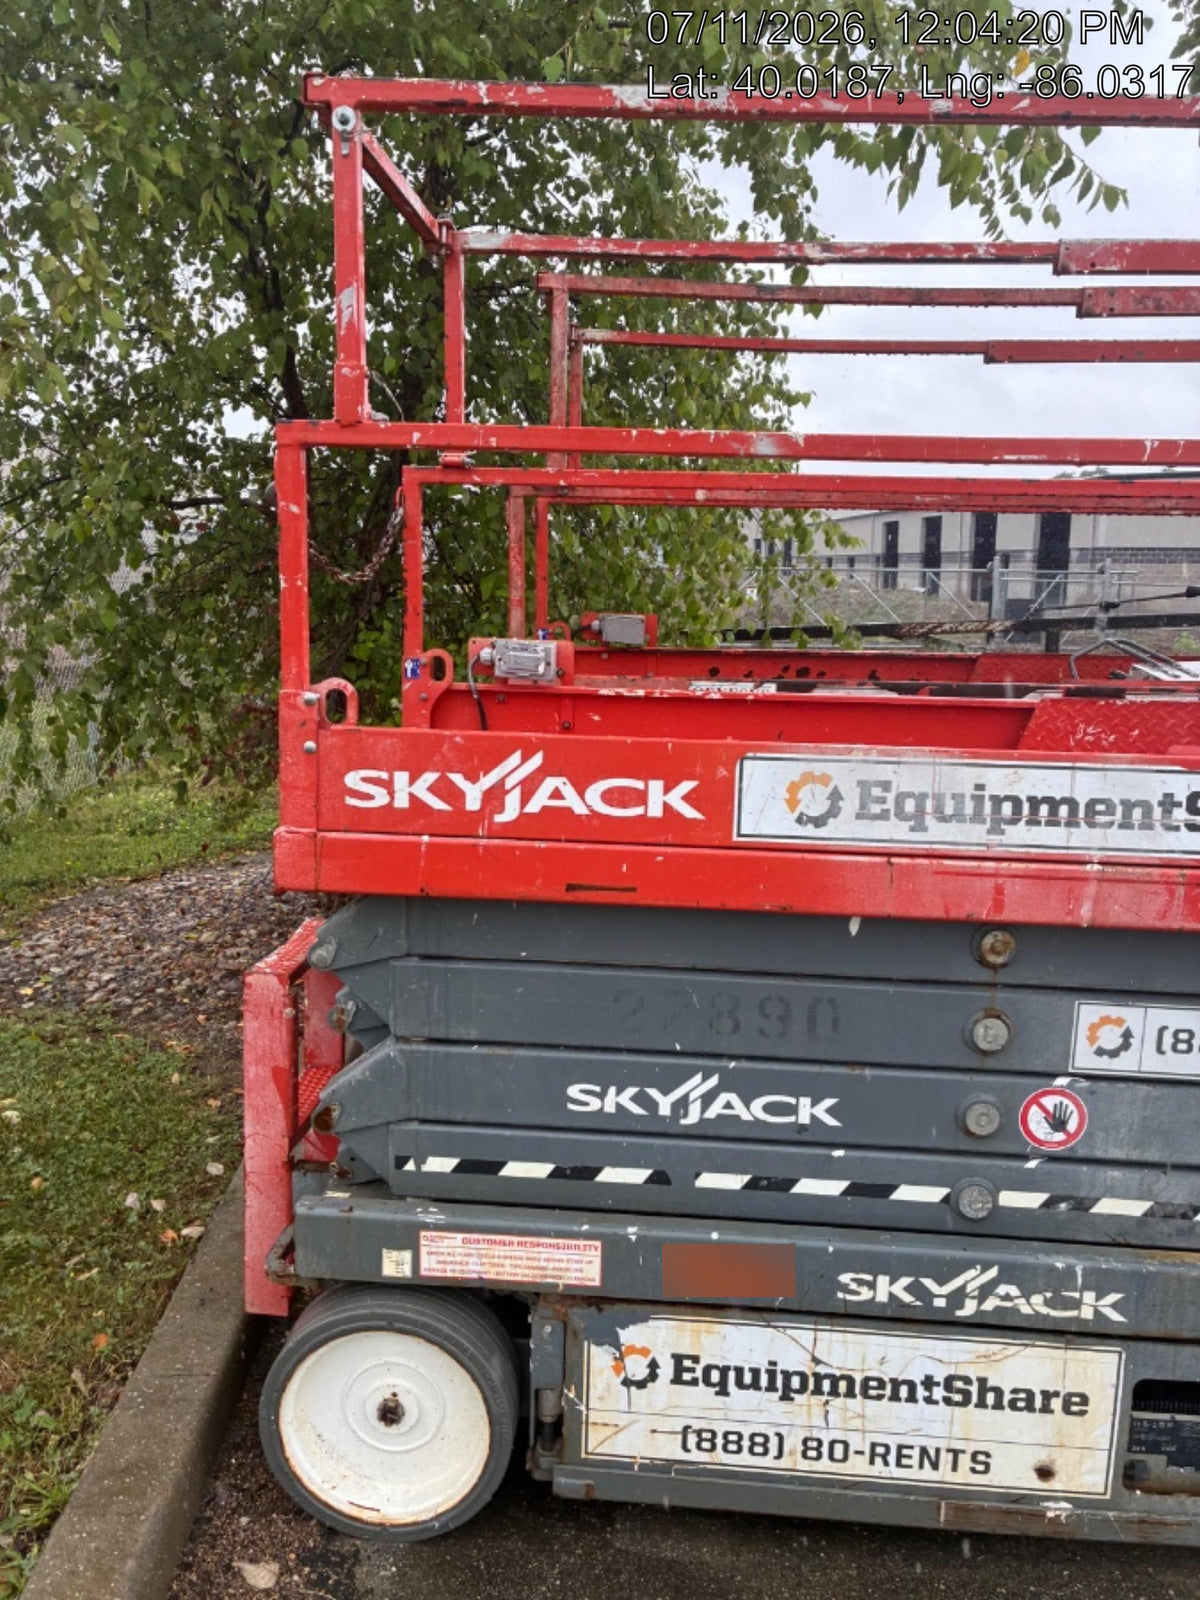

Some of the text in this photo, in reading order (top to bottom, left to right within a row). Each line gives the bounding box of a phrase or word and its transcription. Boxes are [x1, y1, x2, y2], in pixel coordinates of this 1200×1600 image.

[343, 749, 706, 823] SKYJACK
[1155, 1025, 1200, 1055] (8
[566, 1071, 843, 1126] SKYJACK
[461, 1236, 515, 1248] CUSTOMER
[517, 1240, 600, 1253] RESPONSIBILITY
[836, 1264, 1129, 1323] SKYJACK
[669, 1351, 1090, 1417] EquipmentShare
[681, 1425, 993, 1476] (888) 80-RENTS
